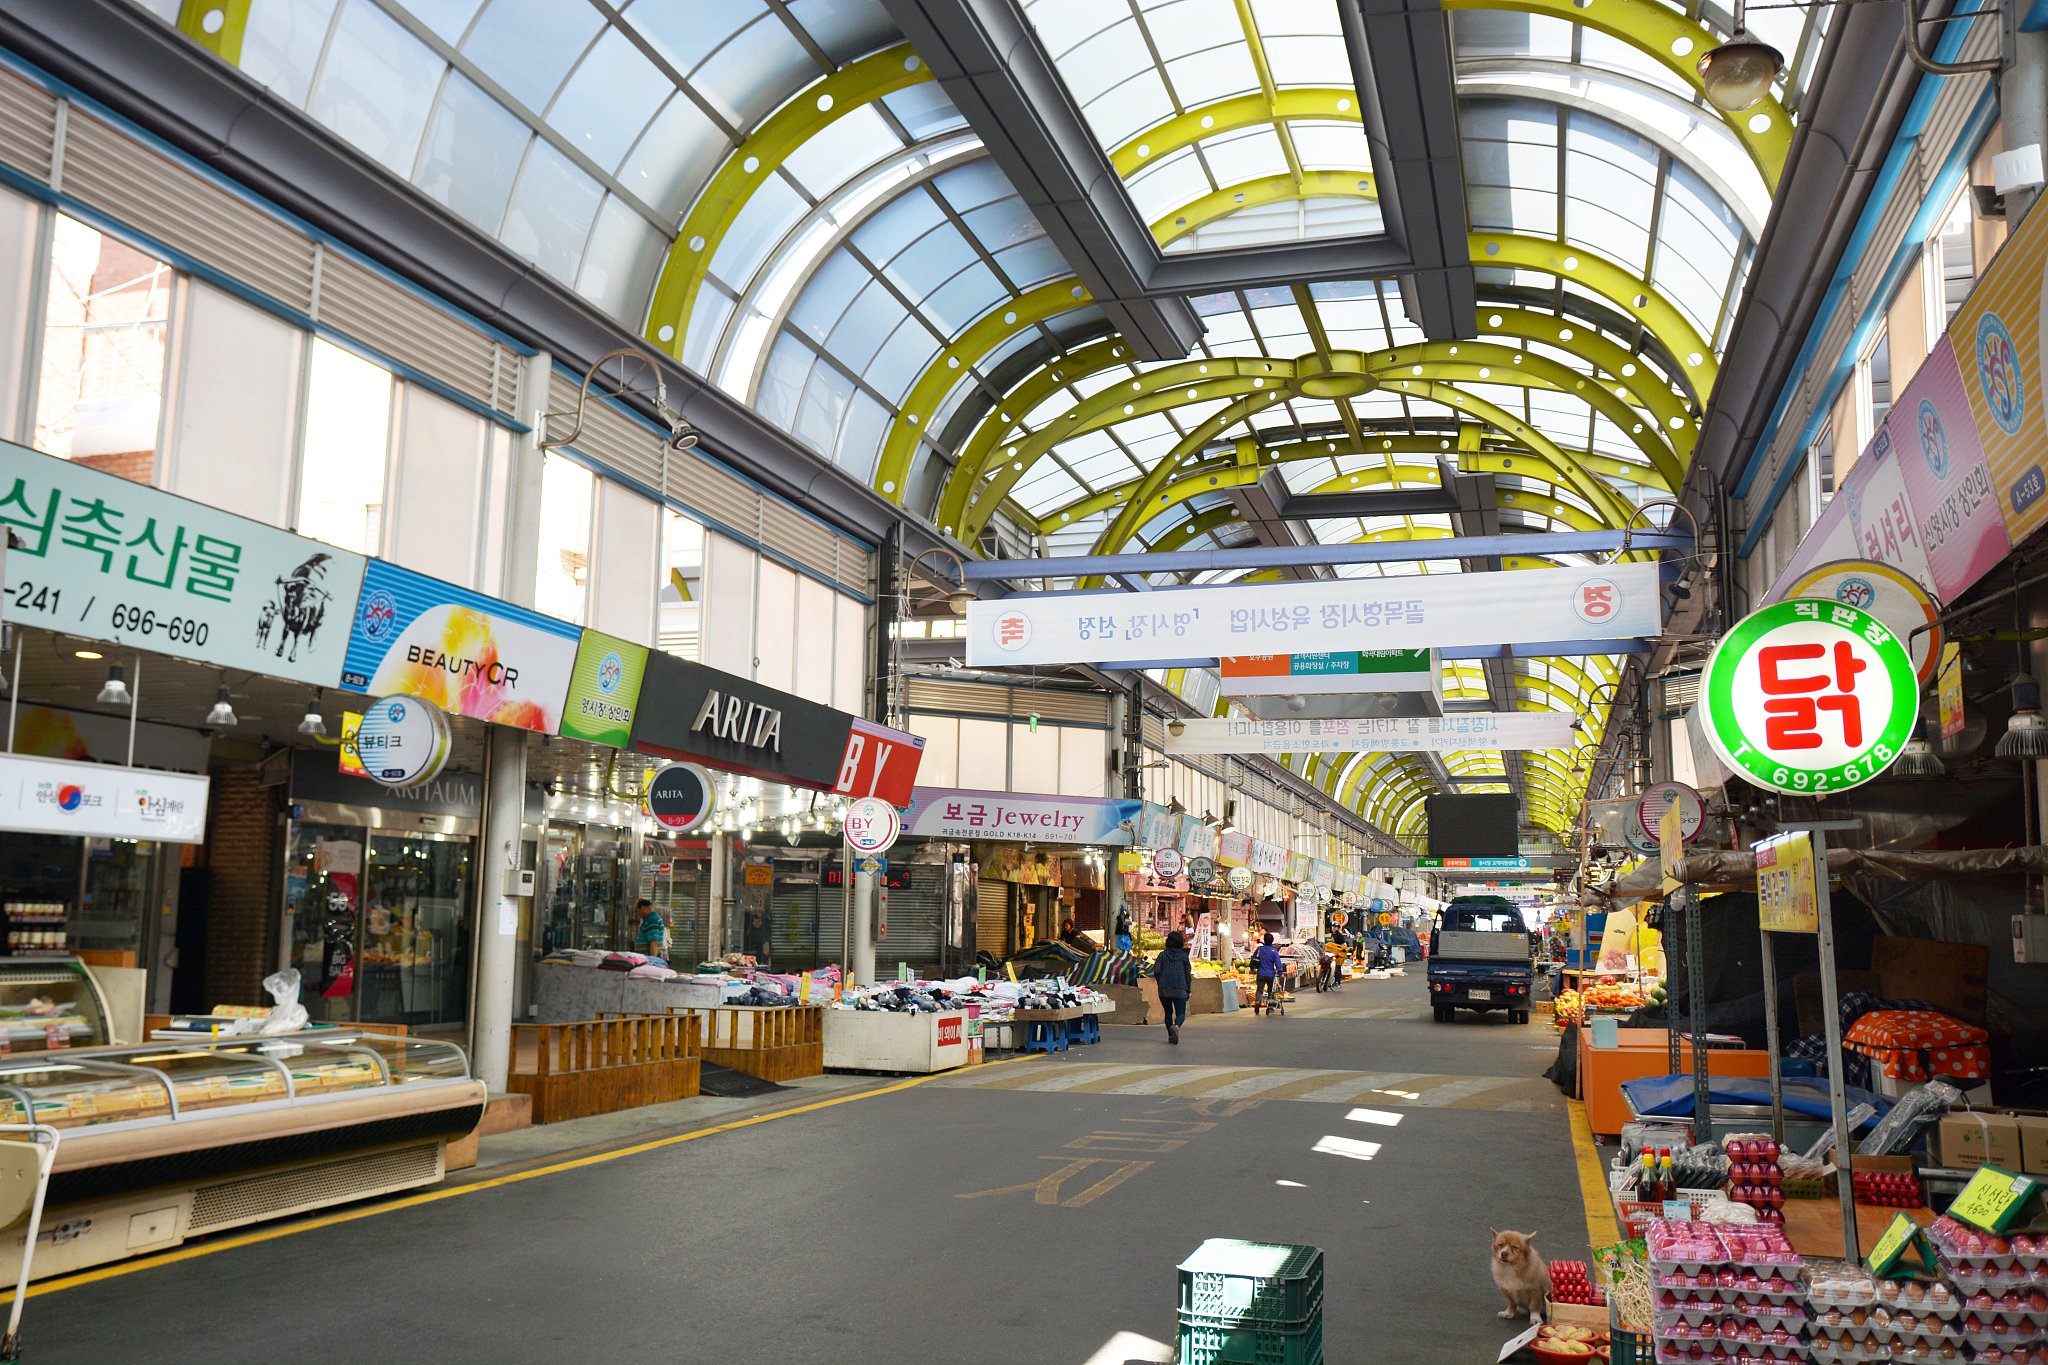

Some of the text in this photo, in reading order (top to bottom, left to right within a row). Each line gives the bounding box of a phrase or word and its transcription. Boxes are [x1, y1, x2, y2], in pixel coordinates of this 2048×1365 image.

[2016, 474, 2041, 507] A-53호
[1923, 462, 1991, 552] 신영시장 상인회
[0, 478, 242, 603] 심축산물
[112, 603, 209, 647] 696-690
[1795, 602, 1891, 646] 직판장
[1293, 662, 1324, 671] 공용화장실
[1330, 661, 1349, 670] 주차장
[581, 697, 632, 724] 영시장 상인회
[1758, 640, 1867, 751] 닭
[690, 689, 782, 753] ARITA
[361, 734, 402, 749] 뷰티크
[836, 734, 892, 798] BY
[1773, 743, 1893, 790] 692-678
[655, 789, 684, 800] ARITA
[668, 816, 686, 825] B-93
[852, 818, 874, 829] BY
[942, 803, 1085, 832] 보금 Jewelry
[942, 828, 1077, 841] 귀금속전문점 GOLD K18-K14 691-701
[1978, 1183, 2013, 1212] 신선란
